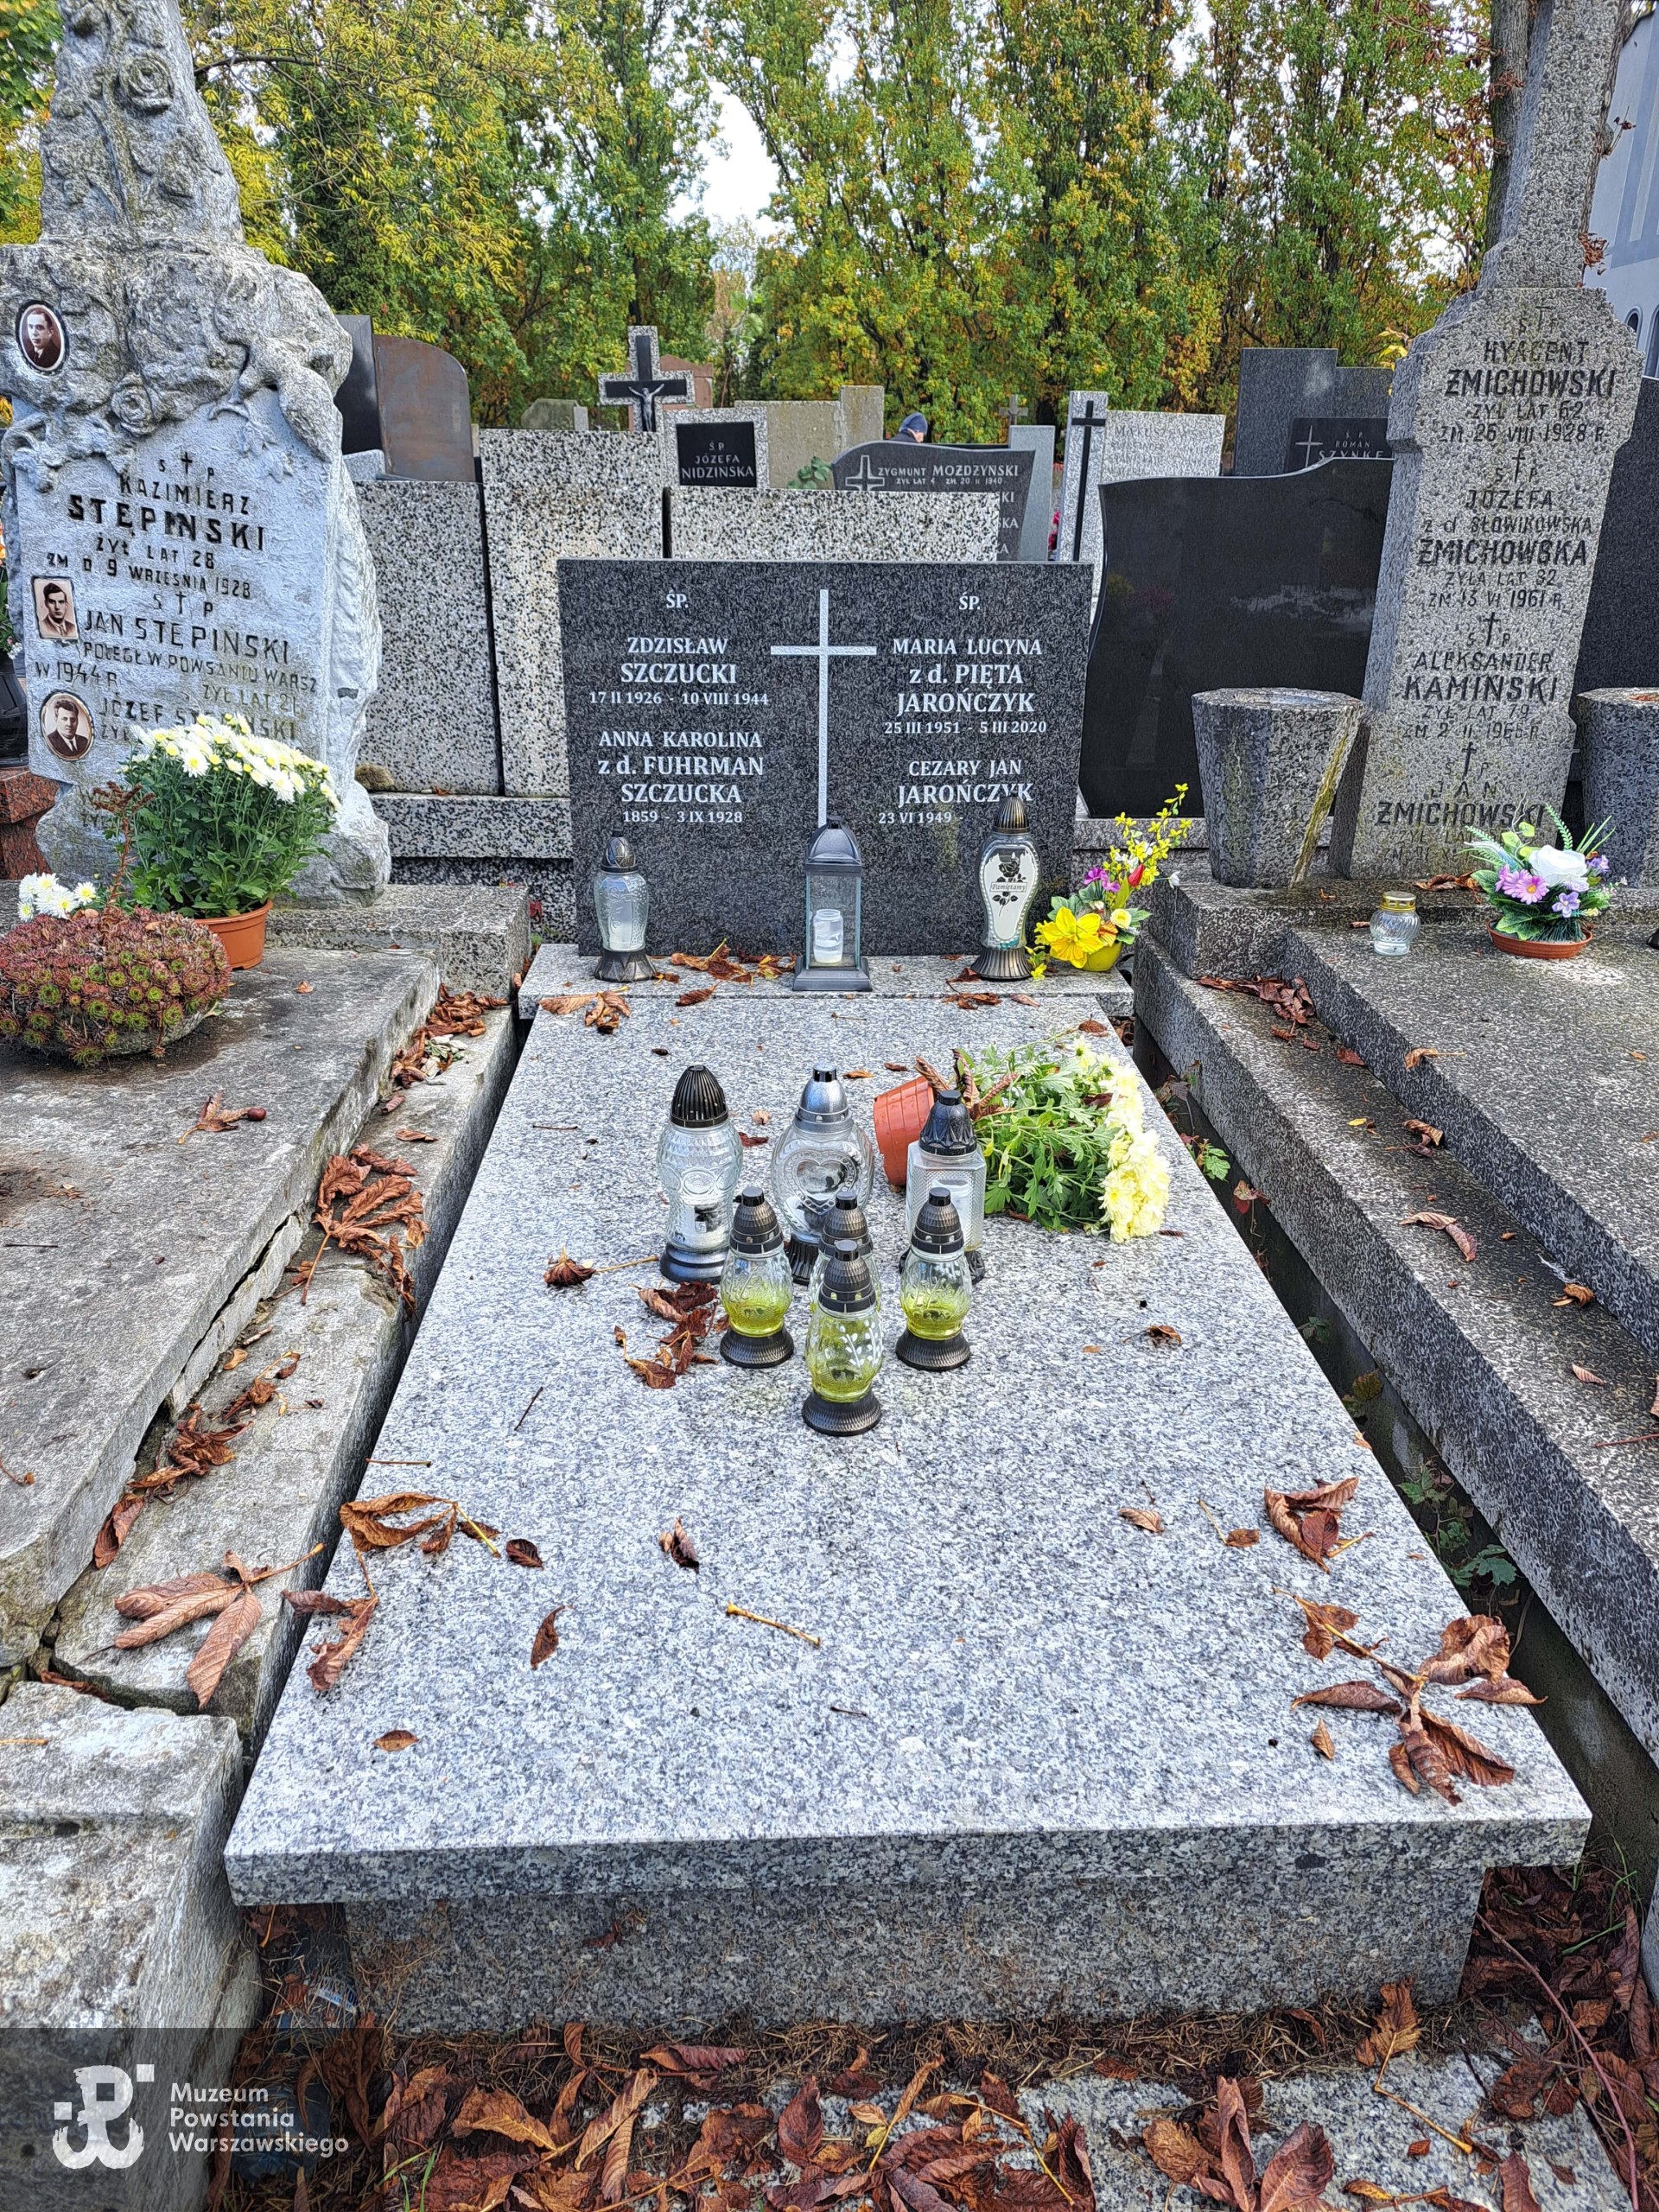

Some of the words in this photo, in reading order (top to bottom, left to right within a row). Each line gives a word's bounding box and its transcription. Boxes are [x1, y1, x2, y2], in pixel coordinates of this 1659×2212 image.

[1483, 340, 1590, 365] HYACENT
[1516, 403, 1549, 420] LAT
[1541, 423, 1588, 442] 1928
[1335, 440, 1370, 448] ROMAN
[695, 453, 741, 465] JÓZEFA
[207, 467, 214, 482] P
[877, 467, 926, 476] ZYGMUNT
[119, 474, 250, 515] KAZIMIERZ
[1443, 517, 1457, 533] d
[147, 544, 179, 563] LAT
[192, 550, 214, 569] 28
[106, 558, 118, 577] 9
[214, 575, 251, 600] 1928
[1497, 571, 1526, 586] LAT
[665, 589, 689, 608] ŚP.
[958, 592, 981, 611] ŚP.
[1510, 588, 1547, 607] 1961
[203, 601, 214, 618] P
[84, 610, 124, 636] JAN
[627, 637, 728, 655] ZDZISŁAW
[893, 638, 957, 655] MARIA
[967, 638, 1042, 655] LUCYNA
[1413, 651, 1552, 672] ALEKSANDER
[35, 661, 50, 677] W
[56, 661, 102, 685] 1944
[107, 671, 118, 687] R
[148, 651, 162, 666] W
[263, 667, 317, 693] WARSZ
[620, 663, 737, 684] SZCZUCKI
[909, 668, 922, 683] z
[927, 663, 948, 684] d.
[955, 664, 1024, 690] PIĘTA
[240, 690, 271, 709] LAT
[589, 691, 606, 704] 17
[610, 691, 622, 704] II
[626, 691, 663, 704] 1926
[682, 692, 700, 705] 10
[703, 692, 729, 705] VIII
[734, 692, 769, 706] 1944
[896, 688, 1036, 717] JAROŃCZYK
[1465, 705, 1497, 721] LAT
[884, 721, 901, 734] 25
[906, 721, 922, 734] III
[925, 721, 961, 734] 1951
[979, 721, 988, 734] 5
[993, 721, 1007, 734] III
[1011, 721, 1047, 733] 2020
[1437, 721, 1449, 738] 2
[598, 731, 653, 747] ANNA
[663, 731, 763, 747] KAROLINA
[598, 760, 610, 774] z
[616, 754, 637, 775] d.
[643, 756, 764, 776] FUHRMAN
[908, 760, 982, 777] CEZARY
[988, 760, 1022, 779] JAN
[620, 783, 742, 804] SZCZUCKA
[898, 779, 1034, 809] JAROŃCZYK
[623, 810, 658, 823] 1859
[677, 810, 685, 823] 3
[690, 810, 704, 823] IX
[708, 810, 743, 823] 1928
[878, 812, 895, 824] 23
[899, 812, 913, 824] VI
[918, 812, 952, 824] 1949
[991, 883, 1027, 892] Pamiętamy
